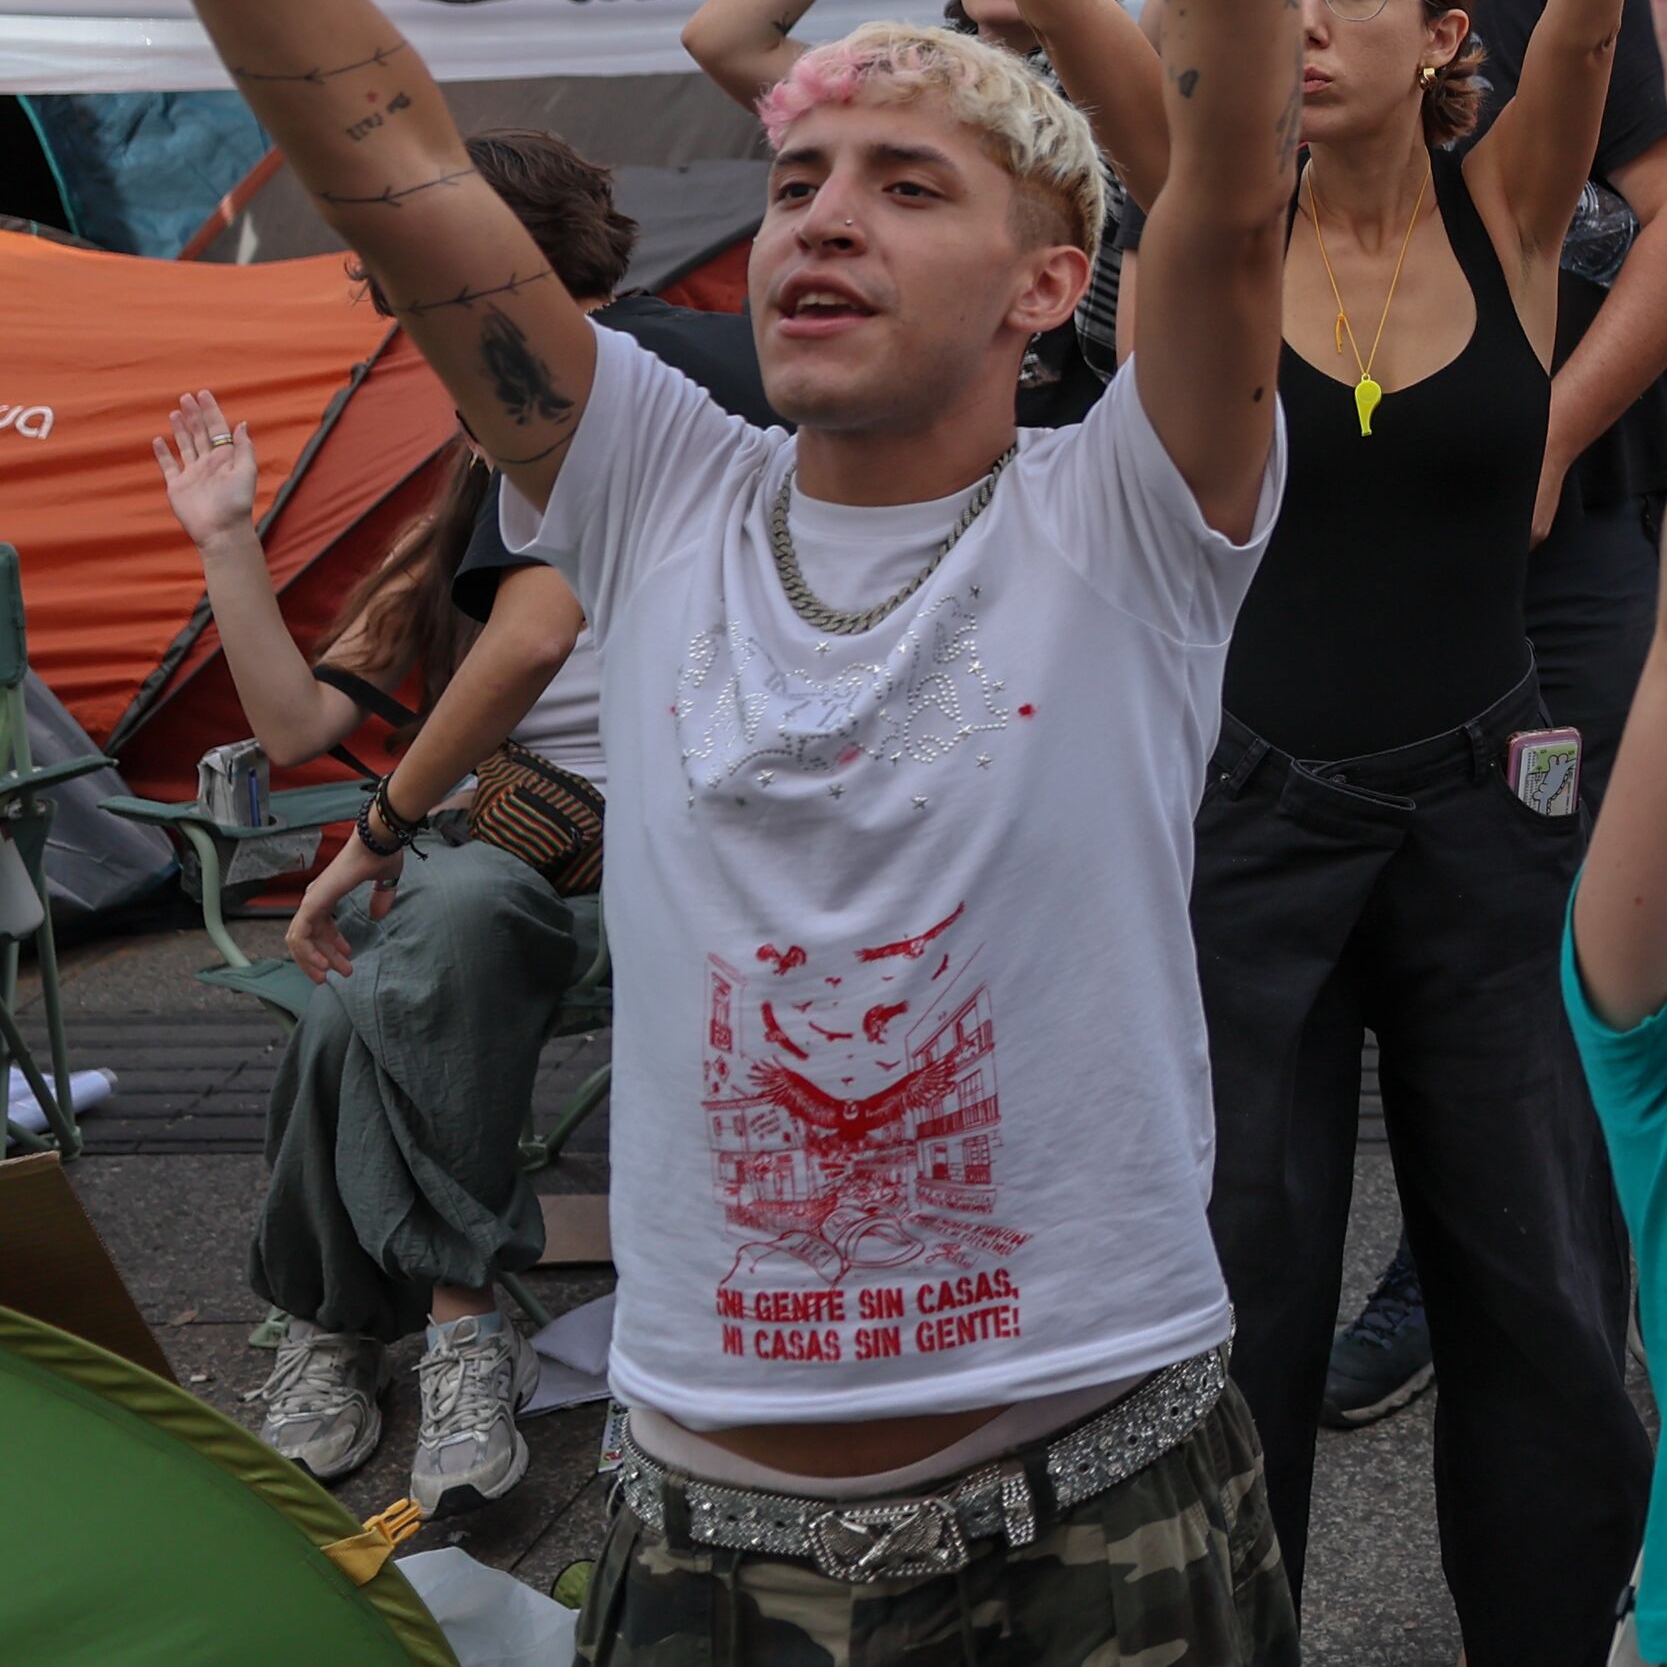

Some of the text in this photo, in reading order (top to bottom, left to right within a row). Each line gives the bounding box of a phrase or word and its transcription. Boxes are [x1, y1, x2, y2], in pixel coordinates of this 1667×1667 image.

[754, 1289, 846, 1323] GENTE
[858, 1286, 905, 1320] SIN
[916, 1267, 1020, 1316] CASAS,
[722, 1305, 1022, 1362] NI CASAS SIN GENTE!
